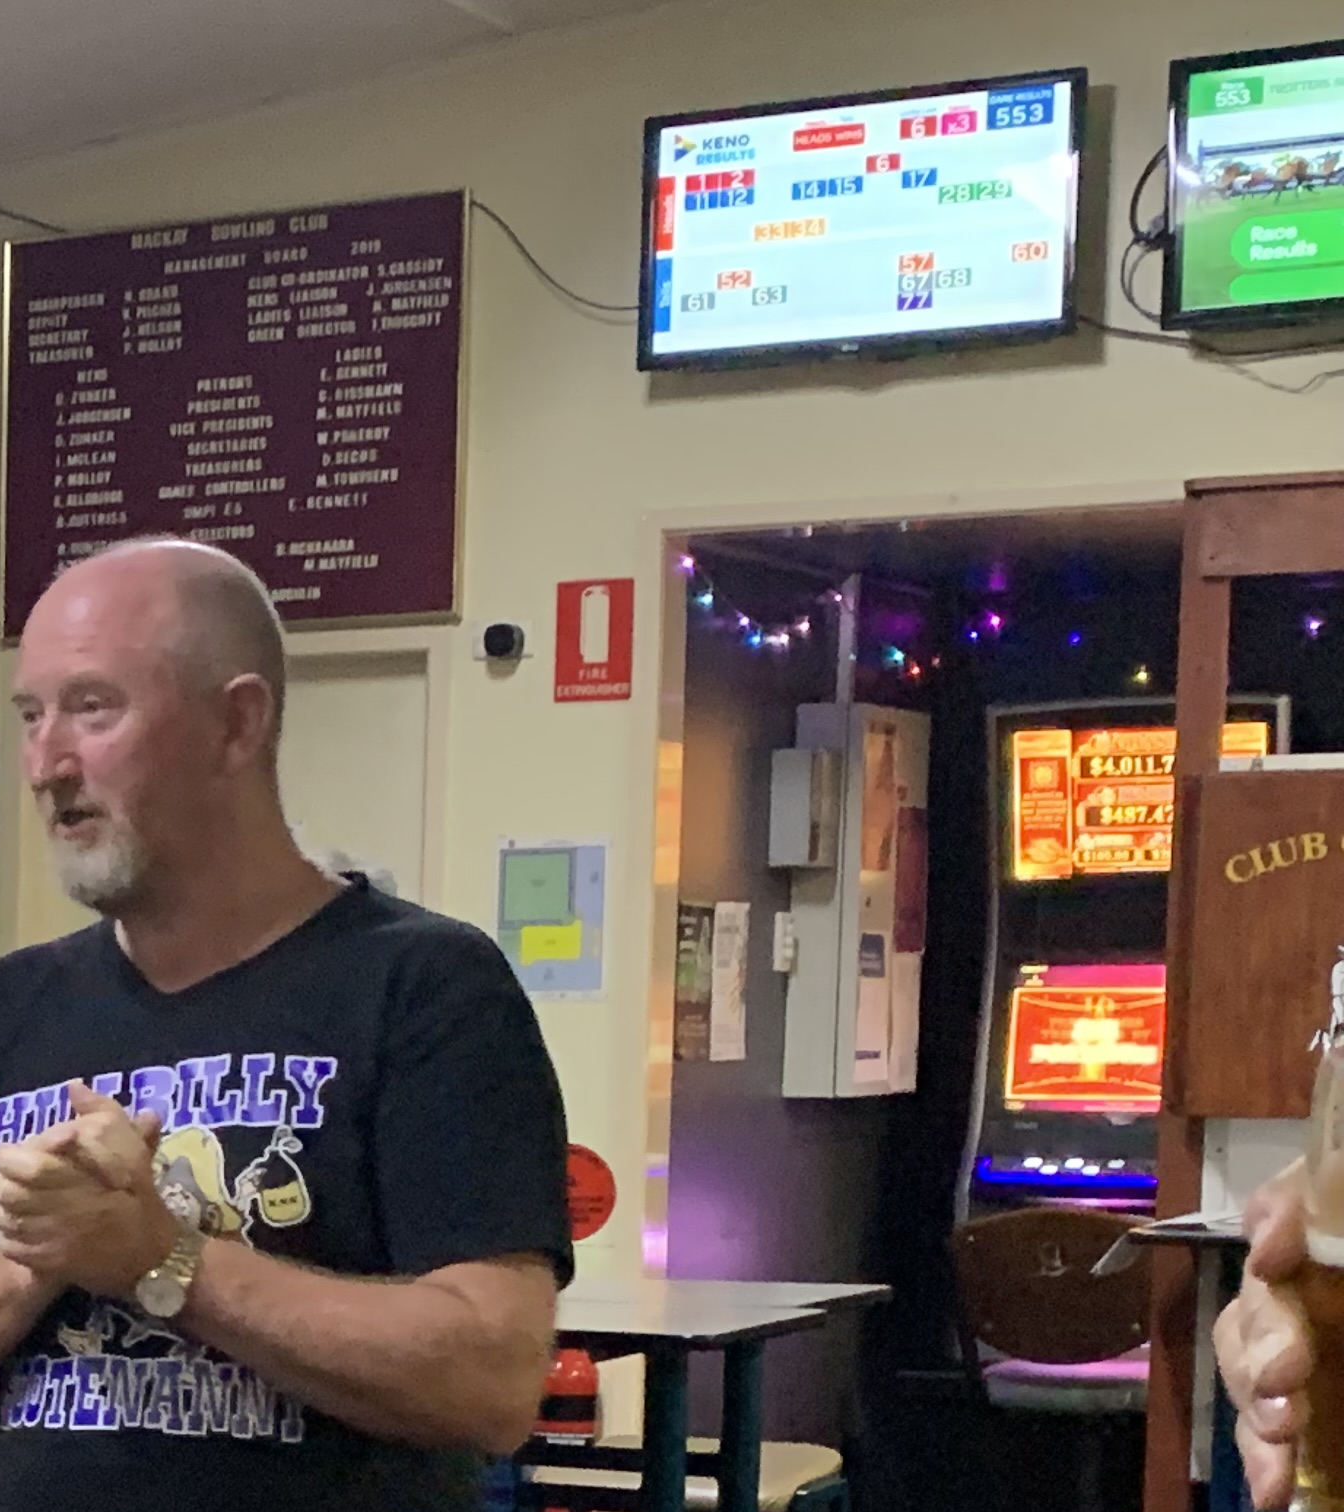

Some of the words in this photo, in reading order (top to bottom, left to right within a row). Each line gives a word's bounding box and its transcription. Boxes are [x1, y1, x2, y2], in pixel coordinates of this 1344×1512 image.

[1215, 89, 1251, 107] 553
[996, 103, 1044, 126] 553
[910, 117, 926, 138] 6
[703, 135, 750, 150] KENO
[696, 148, 755, 165] RESULTS
[876, 155, 890, 173] 6
[730, 169, 745, 188] 2
[799, 180, 821, 198] 14
[836, 177, 857, 195] 15
[908, 168, 930, 188] 17
[727, 187, 748, 207] 12
[941, 183, 971, 203] 28
[978, 180, 1009, 200] 29
[131, 228, 189, 250] MACKAY
[211, 218, 275, 242] BOWLING
[289, 214, 328, 233] CLUB
[1250, 225, 1297, 244] Race
[164, 253, 246, 275] MANAGEMENT
[264, 247, 308, 264] BOARD
[351, 240, 381, 256] 2019
[1250, 240, 1318, 262] Results
[720, 270, 748, 288] 52
[902, 253, 930, 272] 57
[1013, 241, 1046, 261] 60
[248, 274, 278, 290] CLUB
[688, 294, 711, 312] 61
[755, 286, 781, 305] 63
[901, 272, 929, 292] 67
[938, 269, 967, 289] 68
[289, 286, 338, 305] LIAISON
[901, 292, 930, 311] 77
[28, 313, 69, 331] DEPUTY
[248, 309, 291, 326] LADIES
[299, 303, 348, 321] LIAISON
[28, 328, 89, 348] SECRETARY
[297, 320, 356, 339] DIRECTOR
[336, 346, 383, 363] LADIES
[336, 363, 388, 381] BENNETT
[197, 375, 254, 392] PATRONS
[187, 395, 261, 415] PRESIDENTS
[336, 400, 402, 419] MAYFIELD
[169, 422, 196, 437] VICE
[202, 415, 274, 433] PRESIDENTS
[187, 436, 268, 456] SECRETARIES
[185, 457, 263, 477] TREASURERS
[205, 476, 287, 496] CONTROLLERS
[307, 492, 369, 510] BENNETT
[579, 667, 608, 681] FIRE
[556, 682, 630, 698] EXTINGUISHER
[1225, 831, 1328, 883] CLUB
